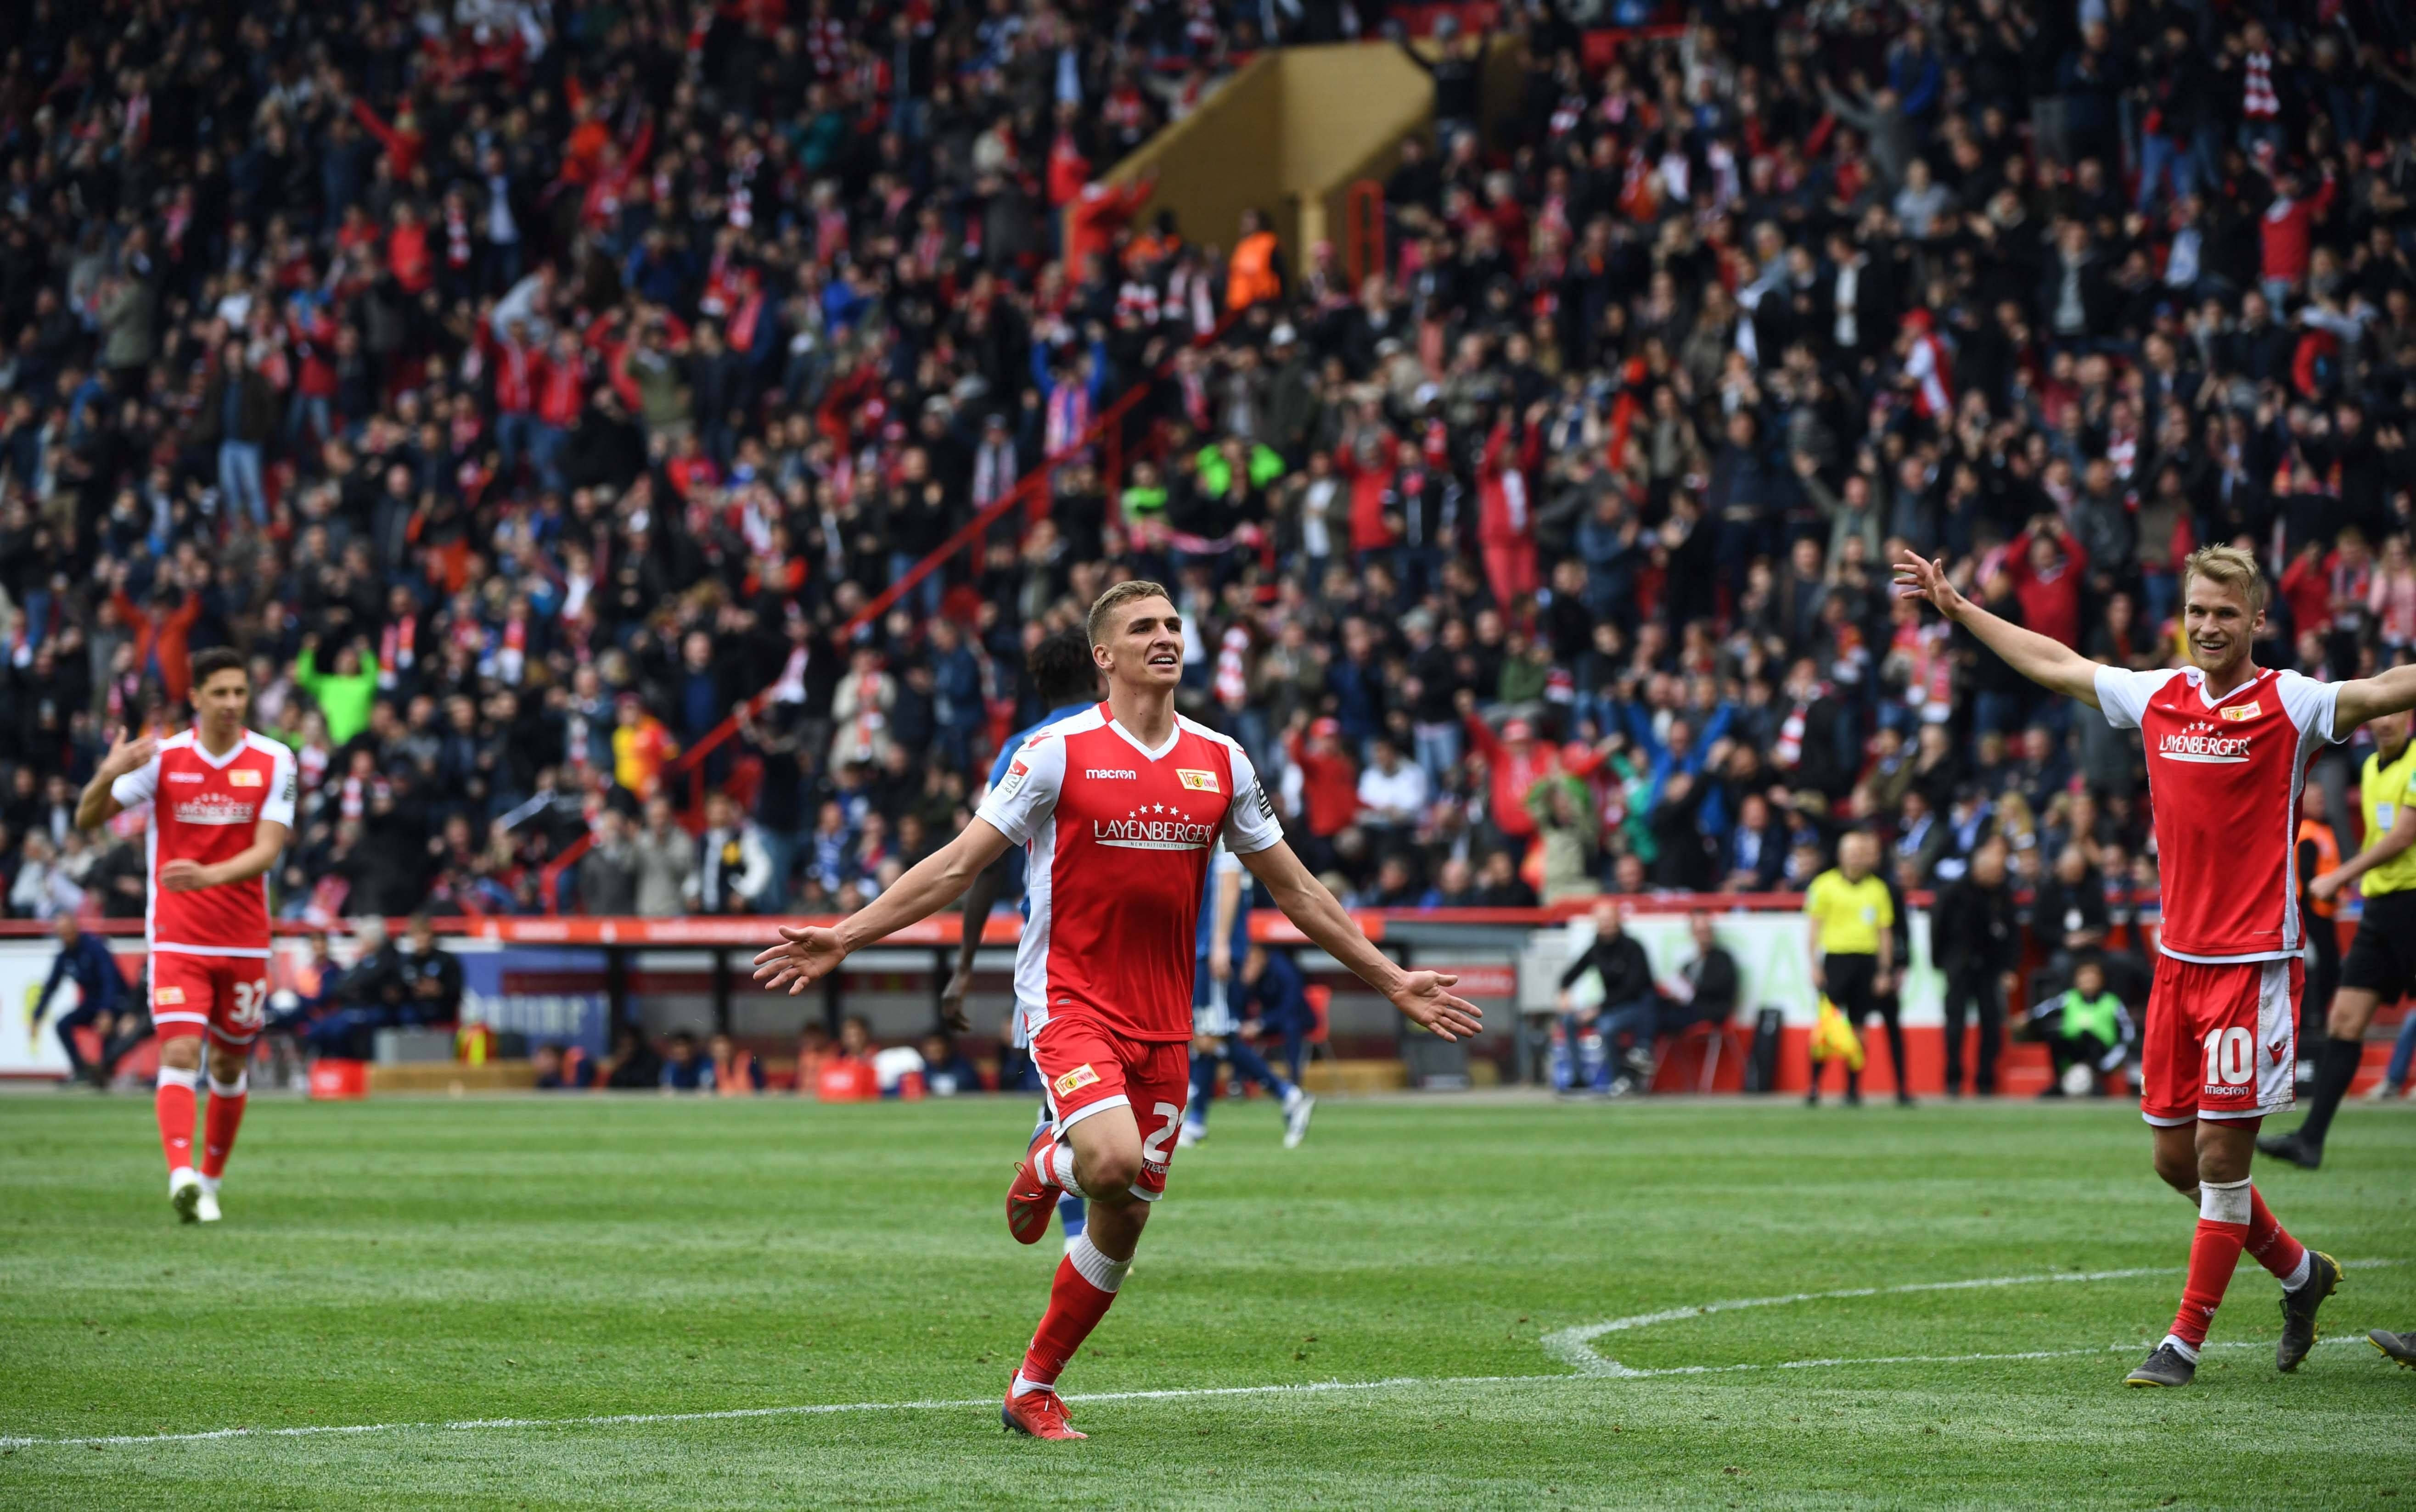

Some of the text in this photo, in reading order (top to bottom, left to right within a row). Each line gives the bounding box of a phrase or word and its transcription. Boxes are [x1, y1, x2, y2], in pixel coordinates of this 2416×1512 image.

[2159, 734, 2250, 756] LAYENBERGER
[1085, 769, 1137, 780] macron
[1094, 819, 1212, 842] LAYENBERGER
[2204, 1026, 2253, 1085] 10
[2204, 1085, 2249, 1095] macron
[1143, 1102, 1186, 1164] 2
[1142, 1160, 1169, 1175] macr
